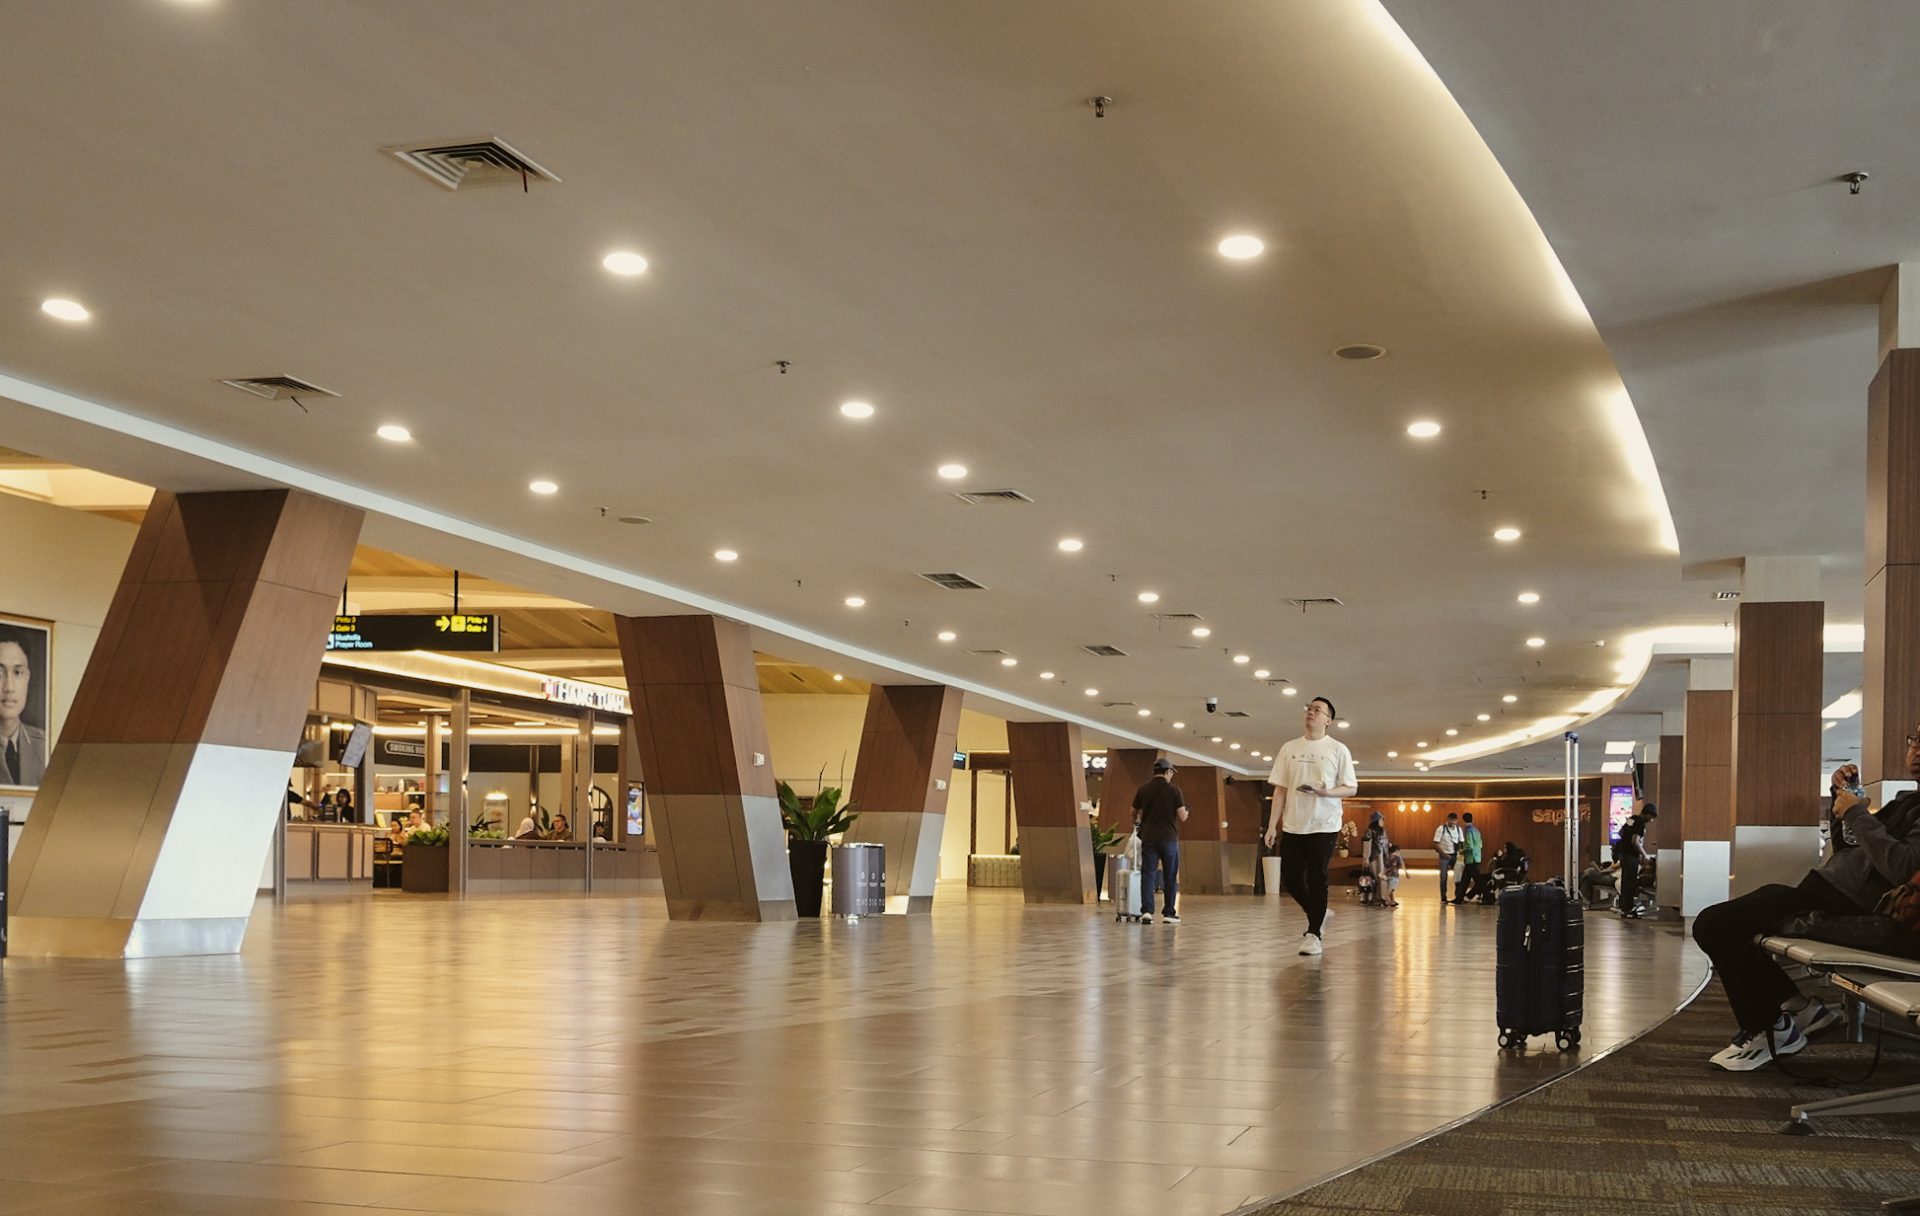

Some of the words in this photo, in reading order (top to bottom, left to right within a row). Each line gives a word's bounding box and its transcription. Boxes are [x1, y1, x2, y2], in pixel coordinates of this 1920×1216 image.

[466, 624, 482, 632] Gate
[335, 641, 354, 649] Prayer
[390, 743, 414, 753] SMOKING
